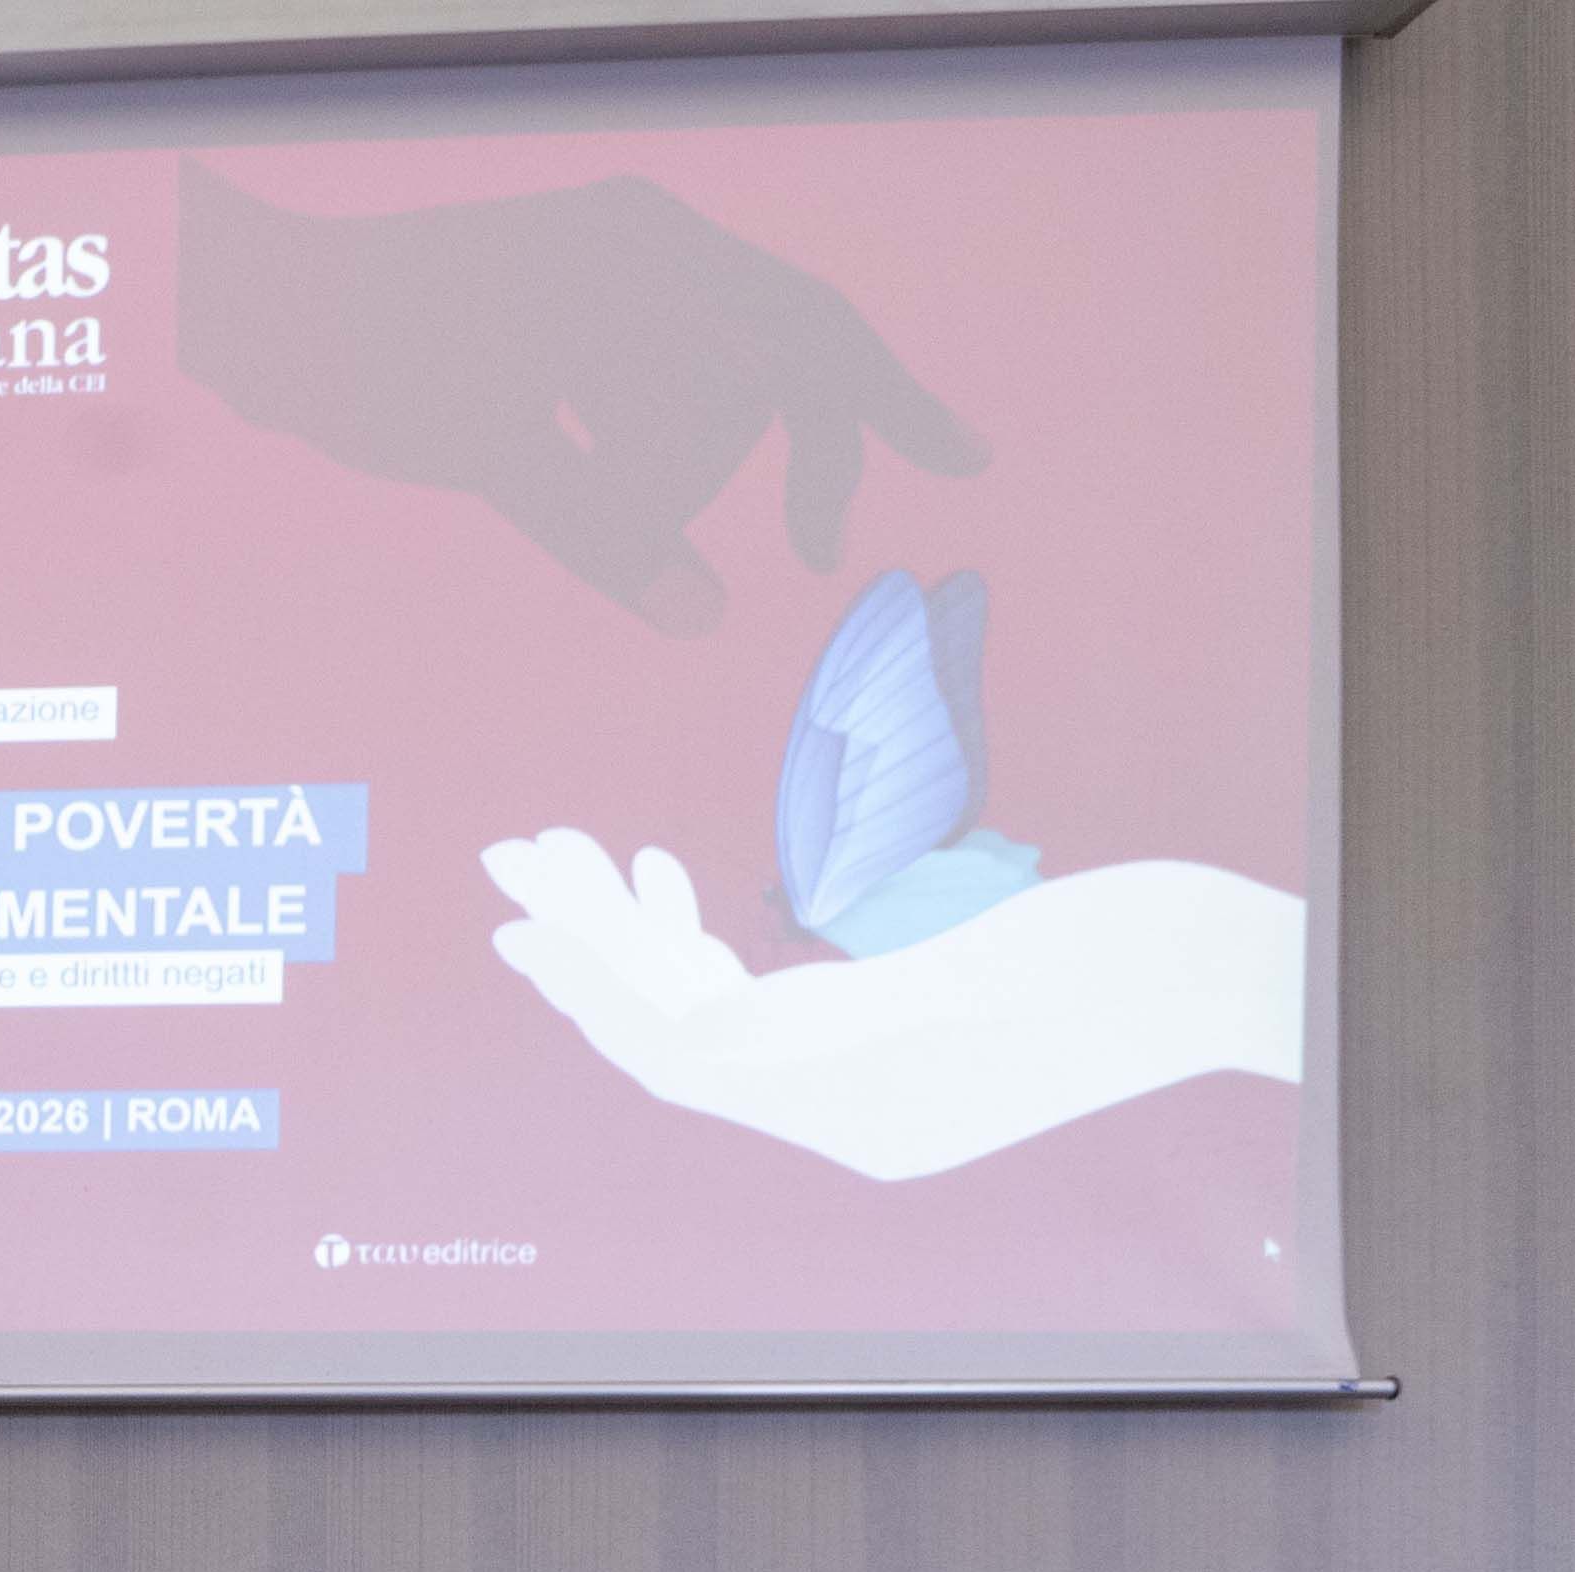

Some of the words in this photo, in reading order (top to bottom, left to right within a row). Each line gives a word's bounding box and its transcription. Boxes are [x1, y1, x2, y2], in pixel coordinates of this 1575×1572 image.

[13, 374, 63, 395] della
[68, 372, 106, 392] CEI
[13, 785, 322, 851] POVERTÀ
[29, 968, 48, 988] e
[162, 957, 267, 993] negati
[127, 1096, 262, 1132] ROMA
